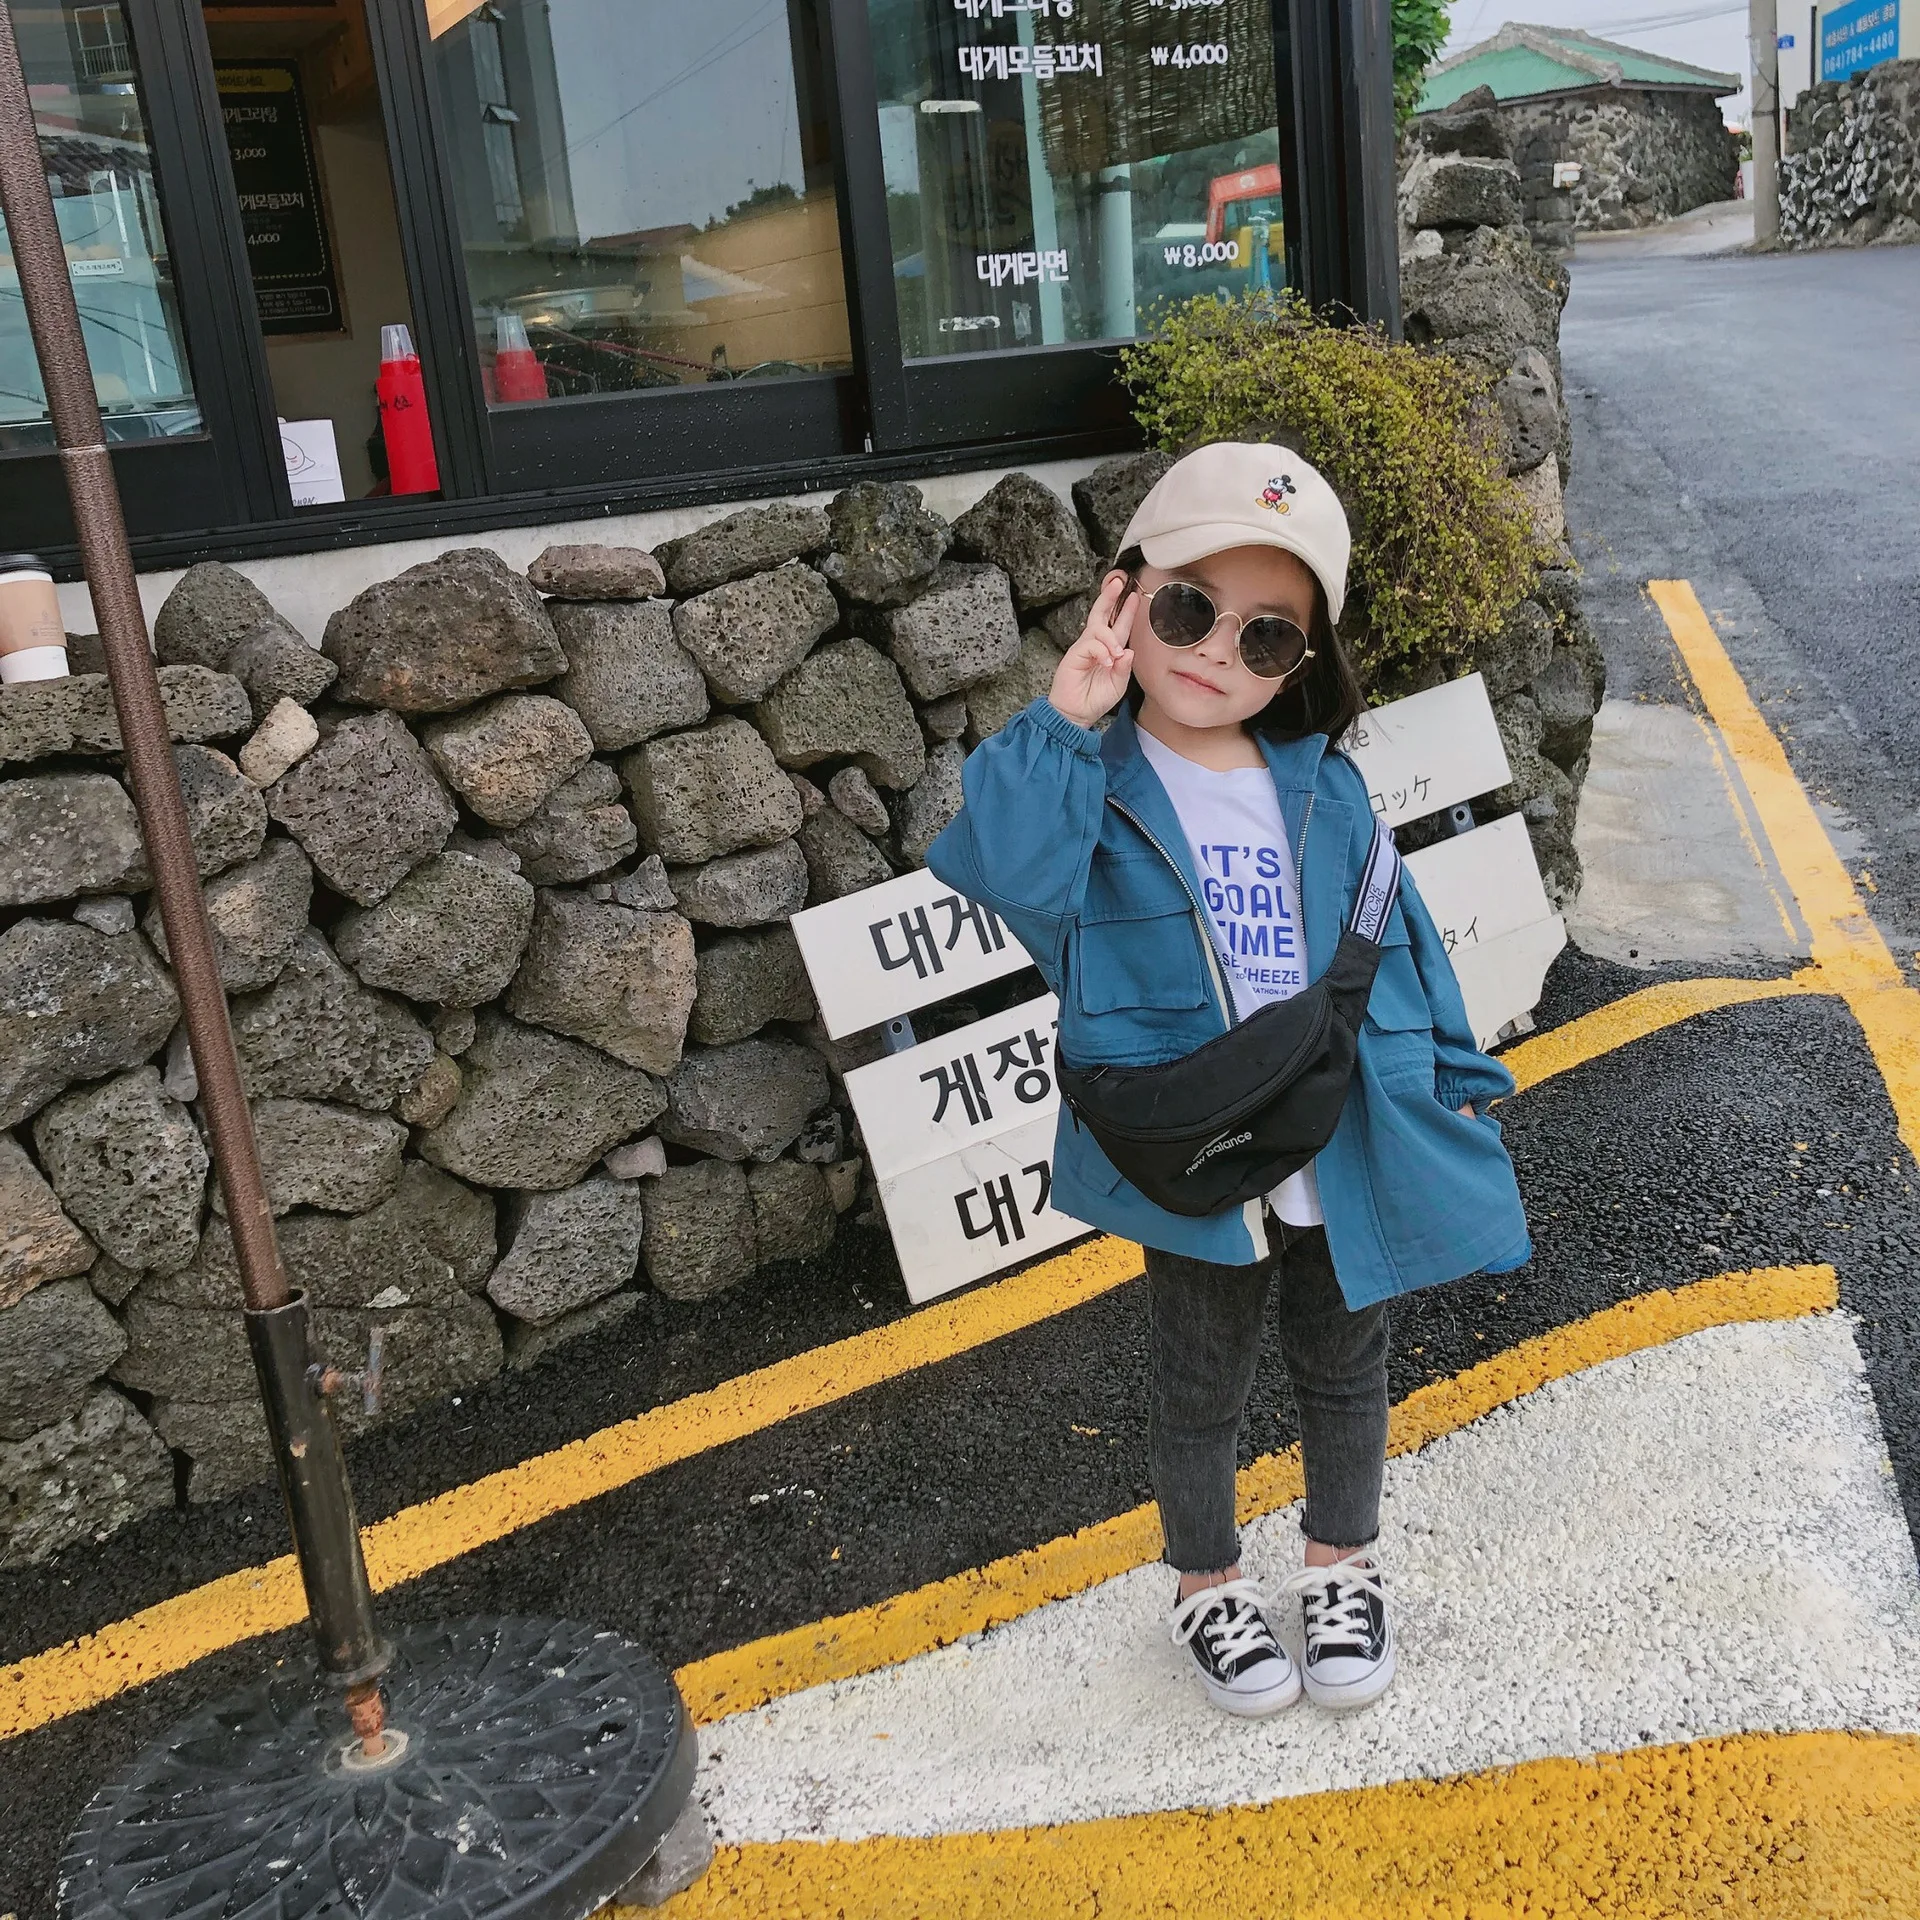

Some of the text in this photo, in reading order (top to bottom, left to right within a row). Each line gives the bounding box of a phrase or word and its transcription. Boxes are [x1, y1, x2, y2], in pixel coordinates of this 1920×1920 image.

[957, 43, 1103, 80] 대게모듬꼬치
[238, 192, 304, 211] 게모듬꼬치
[247, 233, 281, 246] 4,000
[976, 249, 1070, 287] 대게라면
[1203, 878, 1291, 919] GOAL
[868, 895, 1011, 980] 대게
[1244, 967, 1300, 984] HEEZE
[919, 1021, 1060, 1126] 게장
[1205, 1131, 1253, 1158] balance
